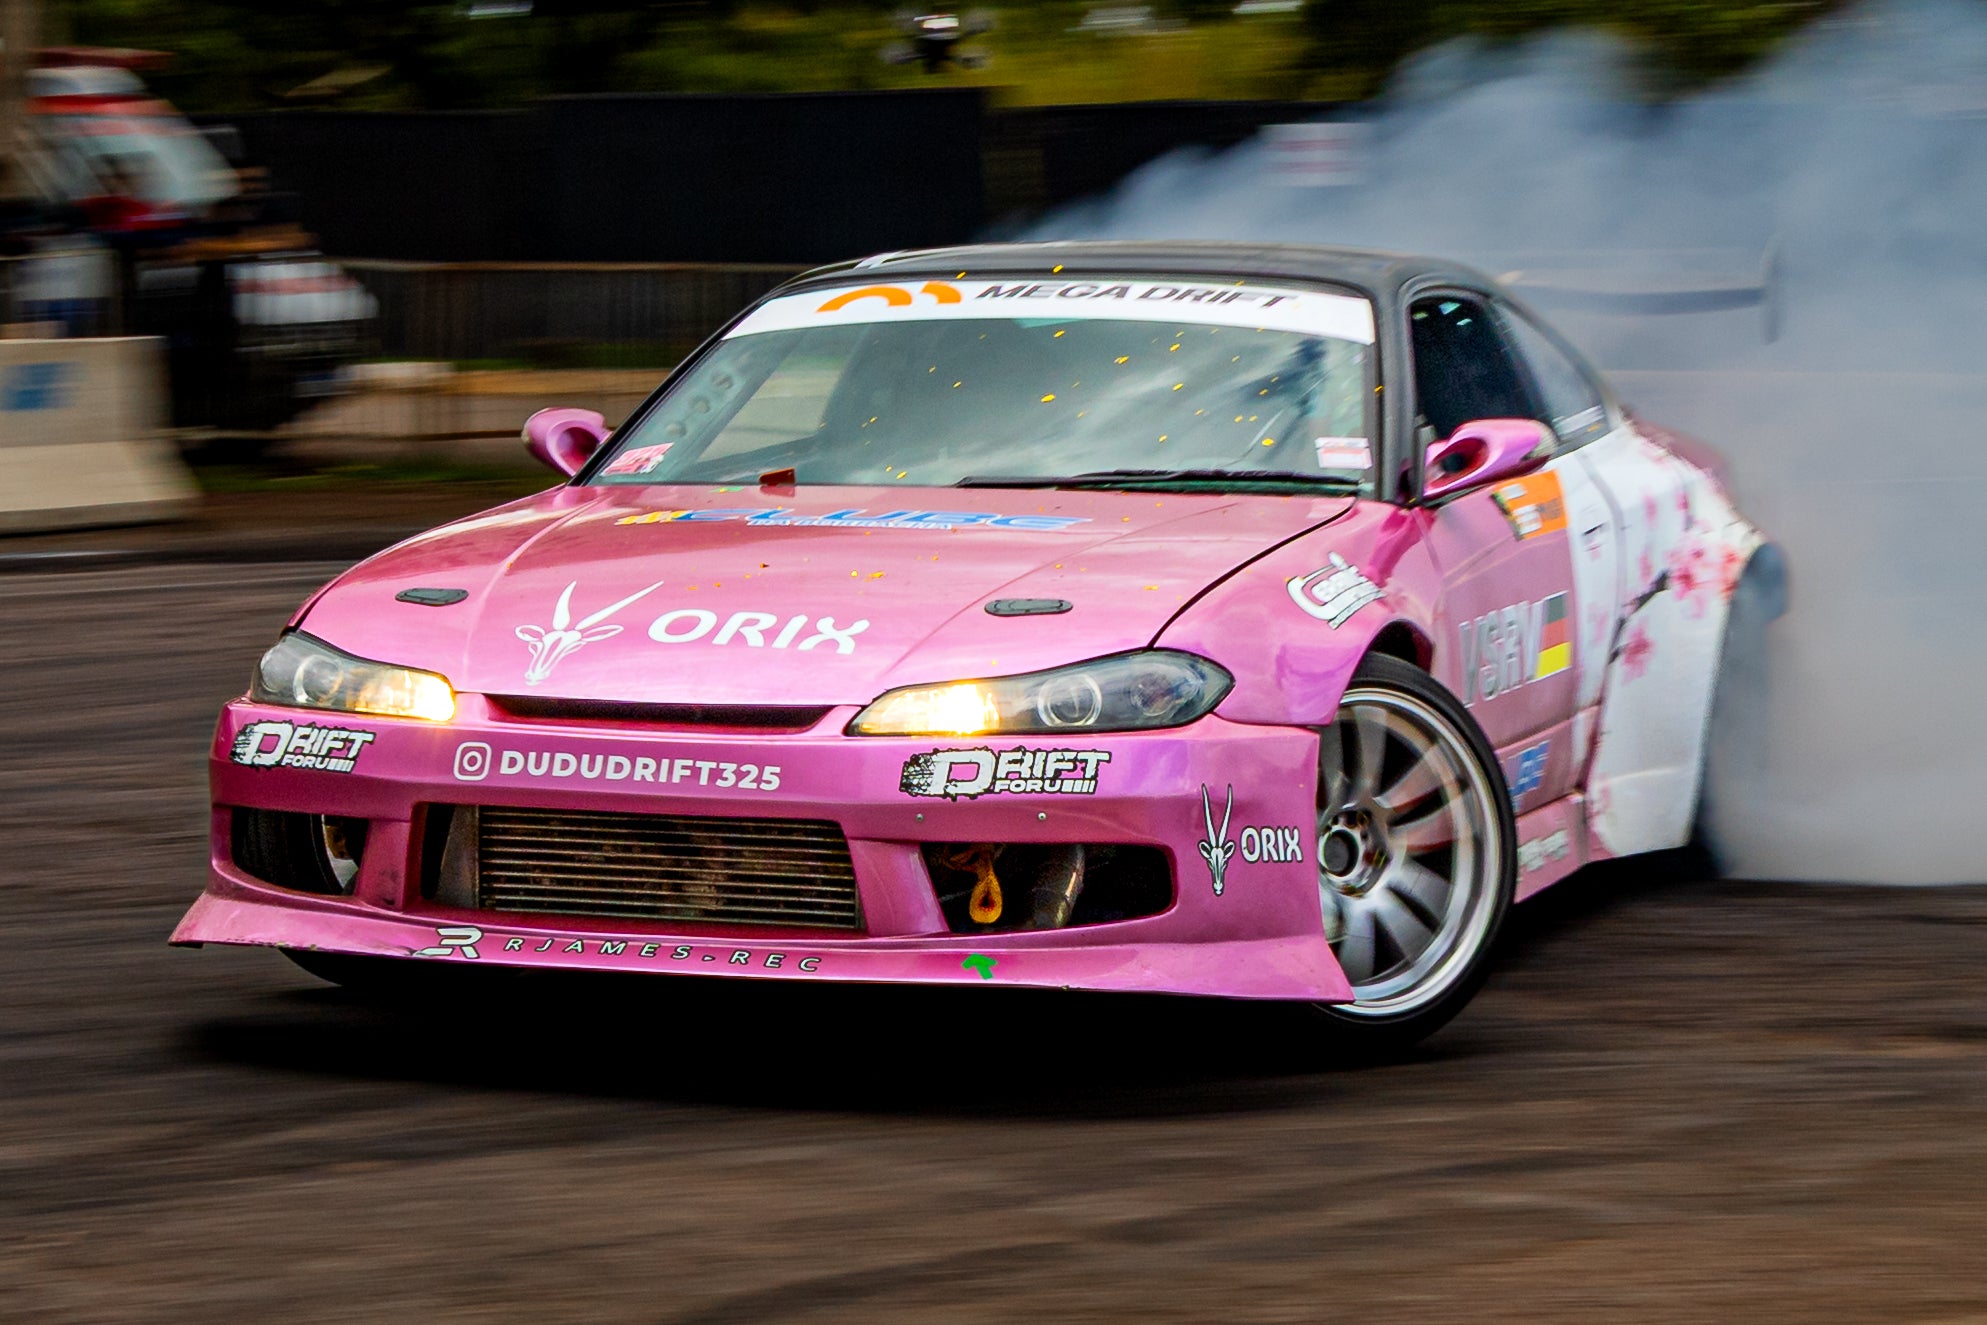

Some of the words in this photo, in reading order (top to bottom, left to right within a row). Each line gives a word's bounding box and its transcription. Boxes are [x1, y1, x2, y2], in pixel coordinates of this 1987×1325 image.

[975, 282, 1132, 299] MEGA
[1138, 285, 1298, 308] DRIFT
[673, 508, 1095, 530] CLUBE
[647, 608, 870, 655] ORIX
[231, 720, 376, 769] DRIFT
[499, 750, 781, 791] DUDUDRIFT325
[901, 749, 1111, 796] DRIFT
[1240, 826, 1303, 863] ORIX
